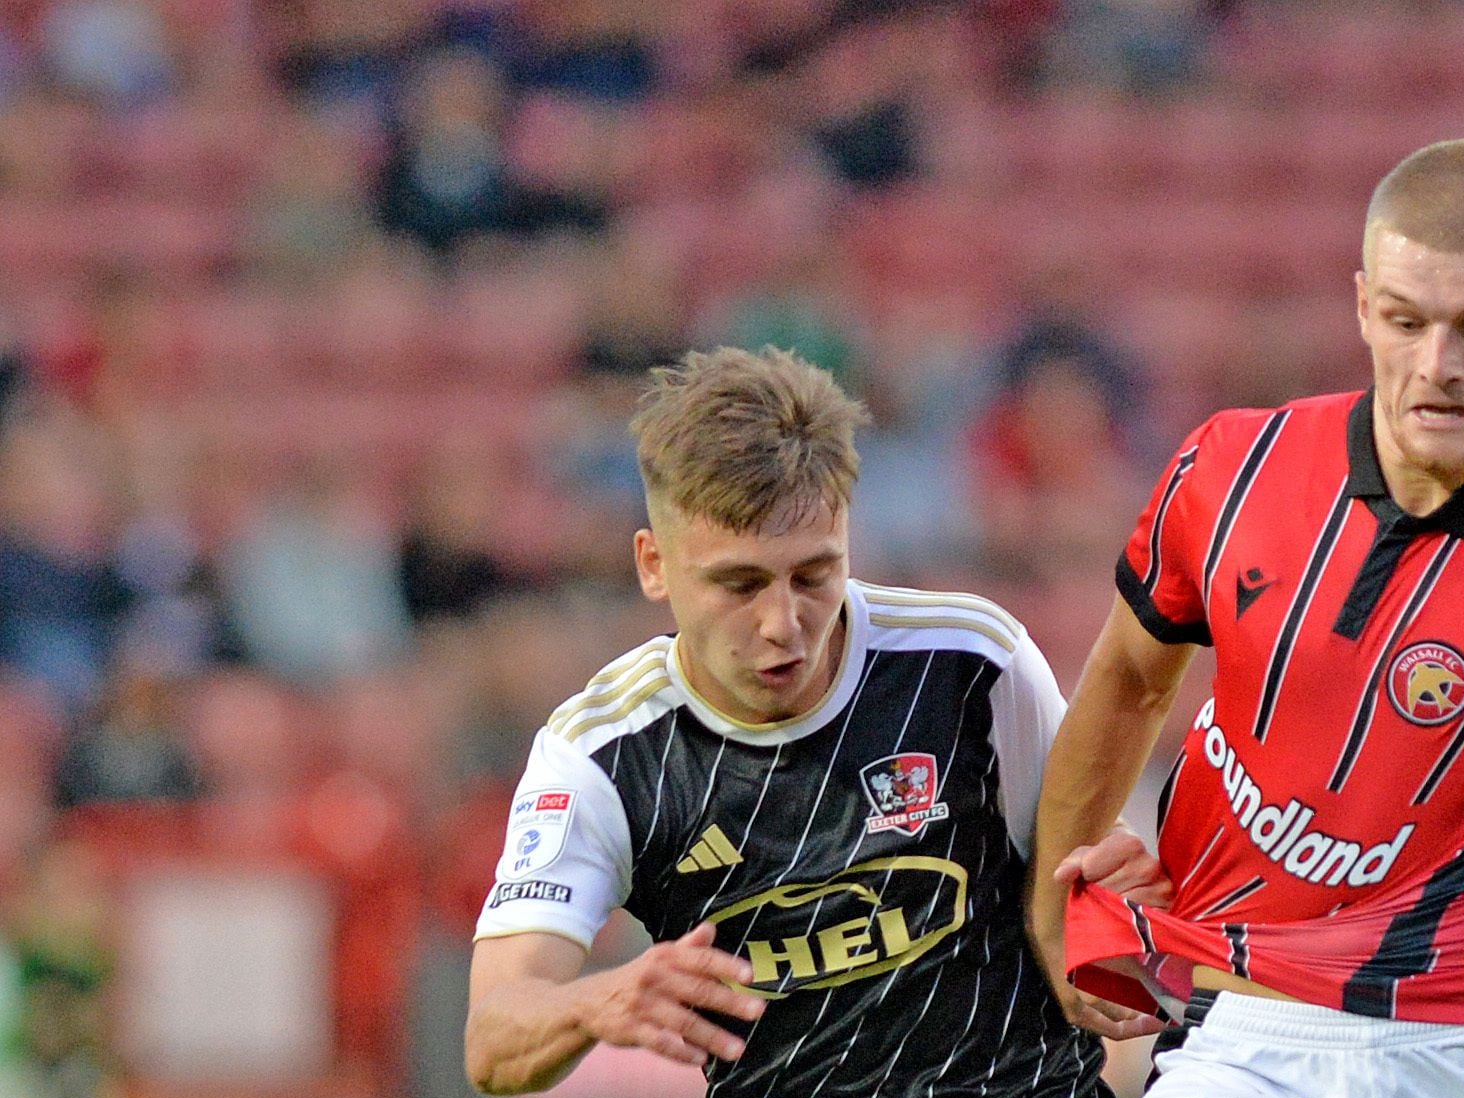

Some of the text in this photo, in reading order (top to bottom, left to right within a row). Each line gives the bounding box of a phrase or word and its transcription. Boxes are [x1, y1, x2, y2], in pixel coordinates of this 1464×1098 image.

[1399, 648, 1444, 672] WALSALL
[1193, 697, 1416, 887] poundland
[515, 794, 567, 815] sky bet
[870, 805, 945, 829] EXETER CITY FC
[514, 857, 531, 872] EFL
[746, 906, 911, 983] HEL
